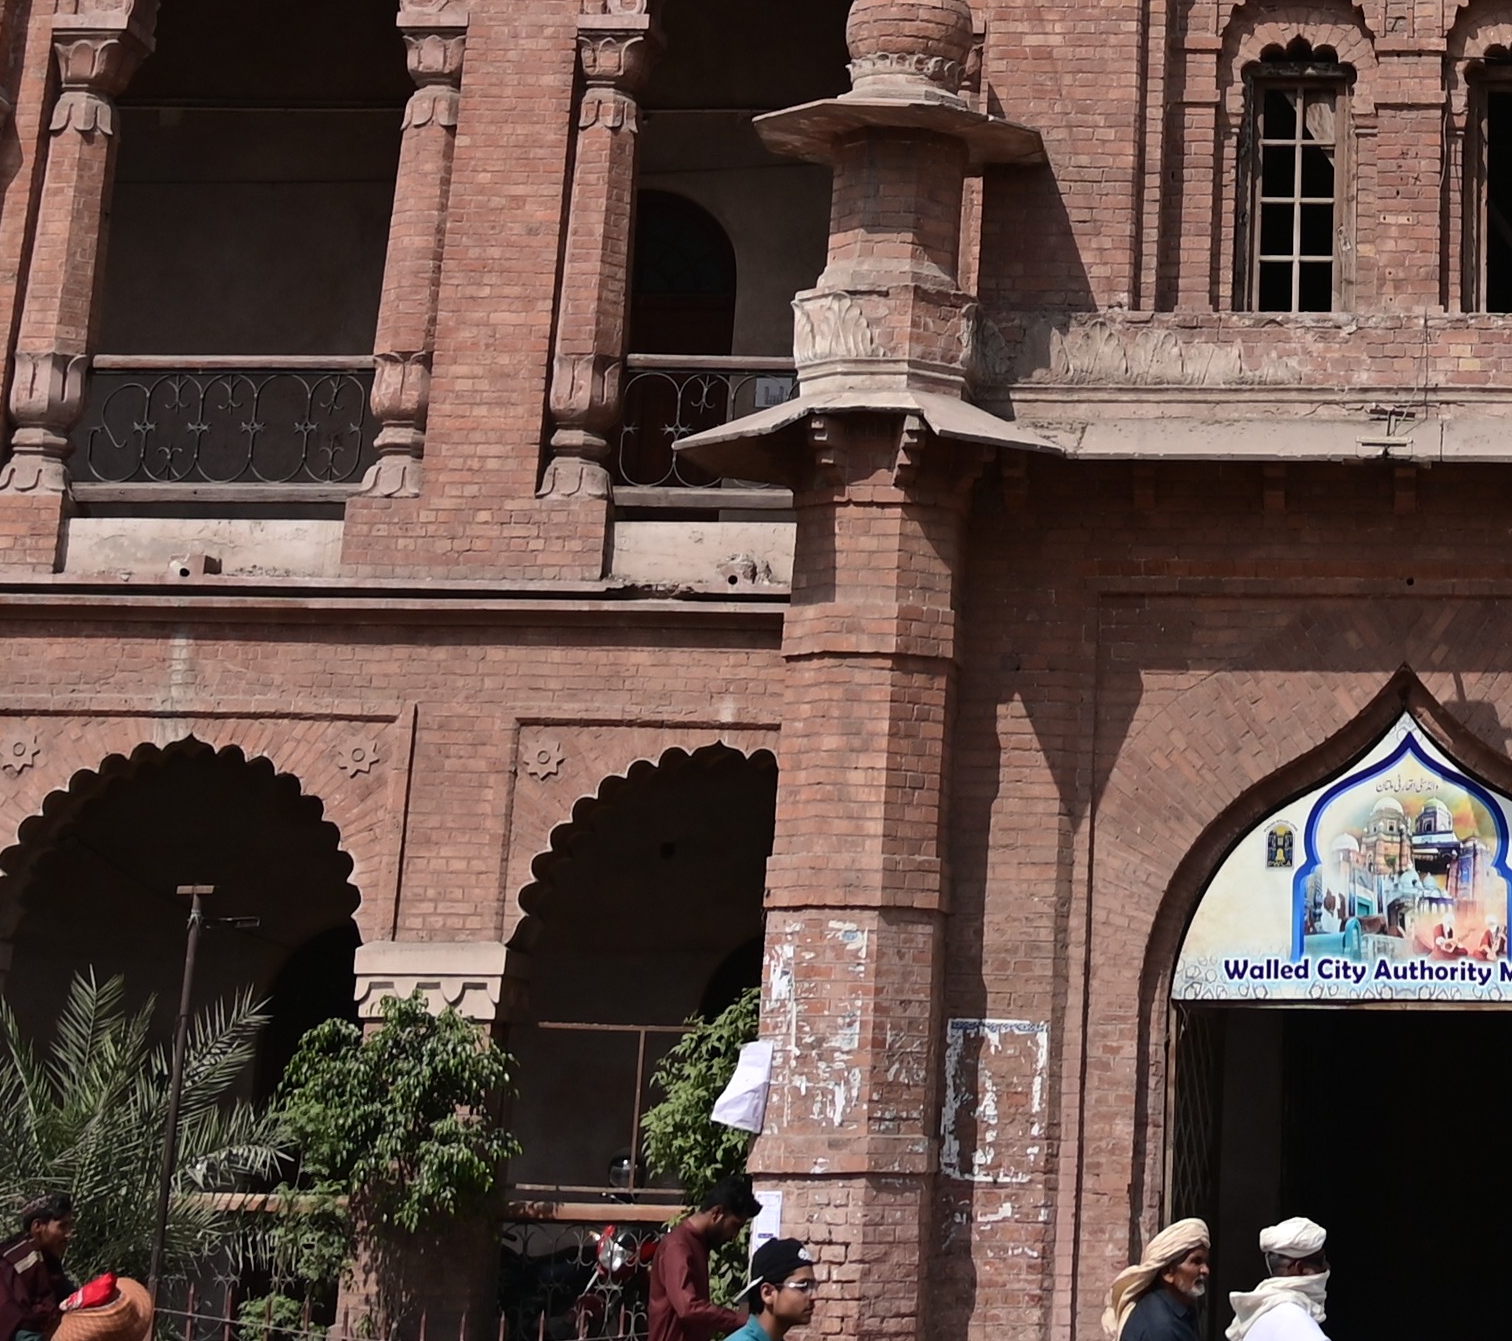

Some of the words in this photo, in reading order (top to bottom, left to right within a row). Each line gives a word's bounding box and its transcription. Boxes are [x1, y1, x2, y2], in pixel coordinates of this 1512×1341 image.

[1224, 959, 1309, 980] Walled
[1317, 959, 1367, 984] City
[1373, 960, 1490, 985] Authority
